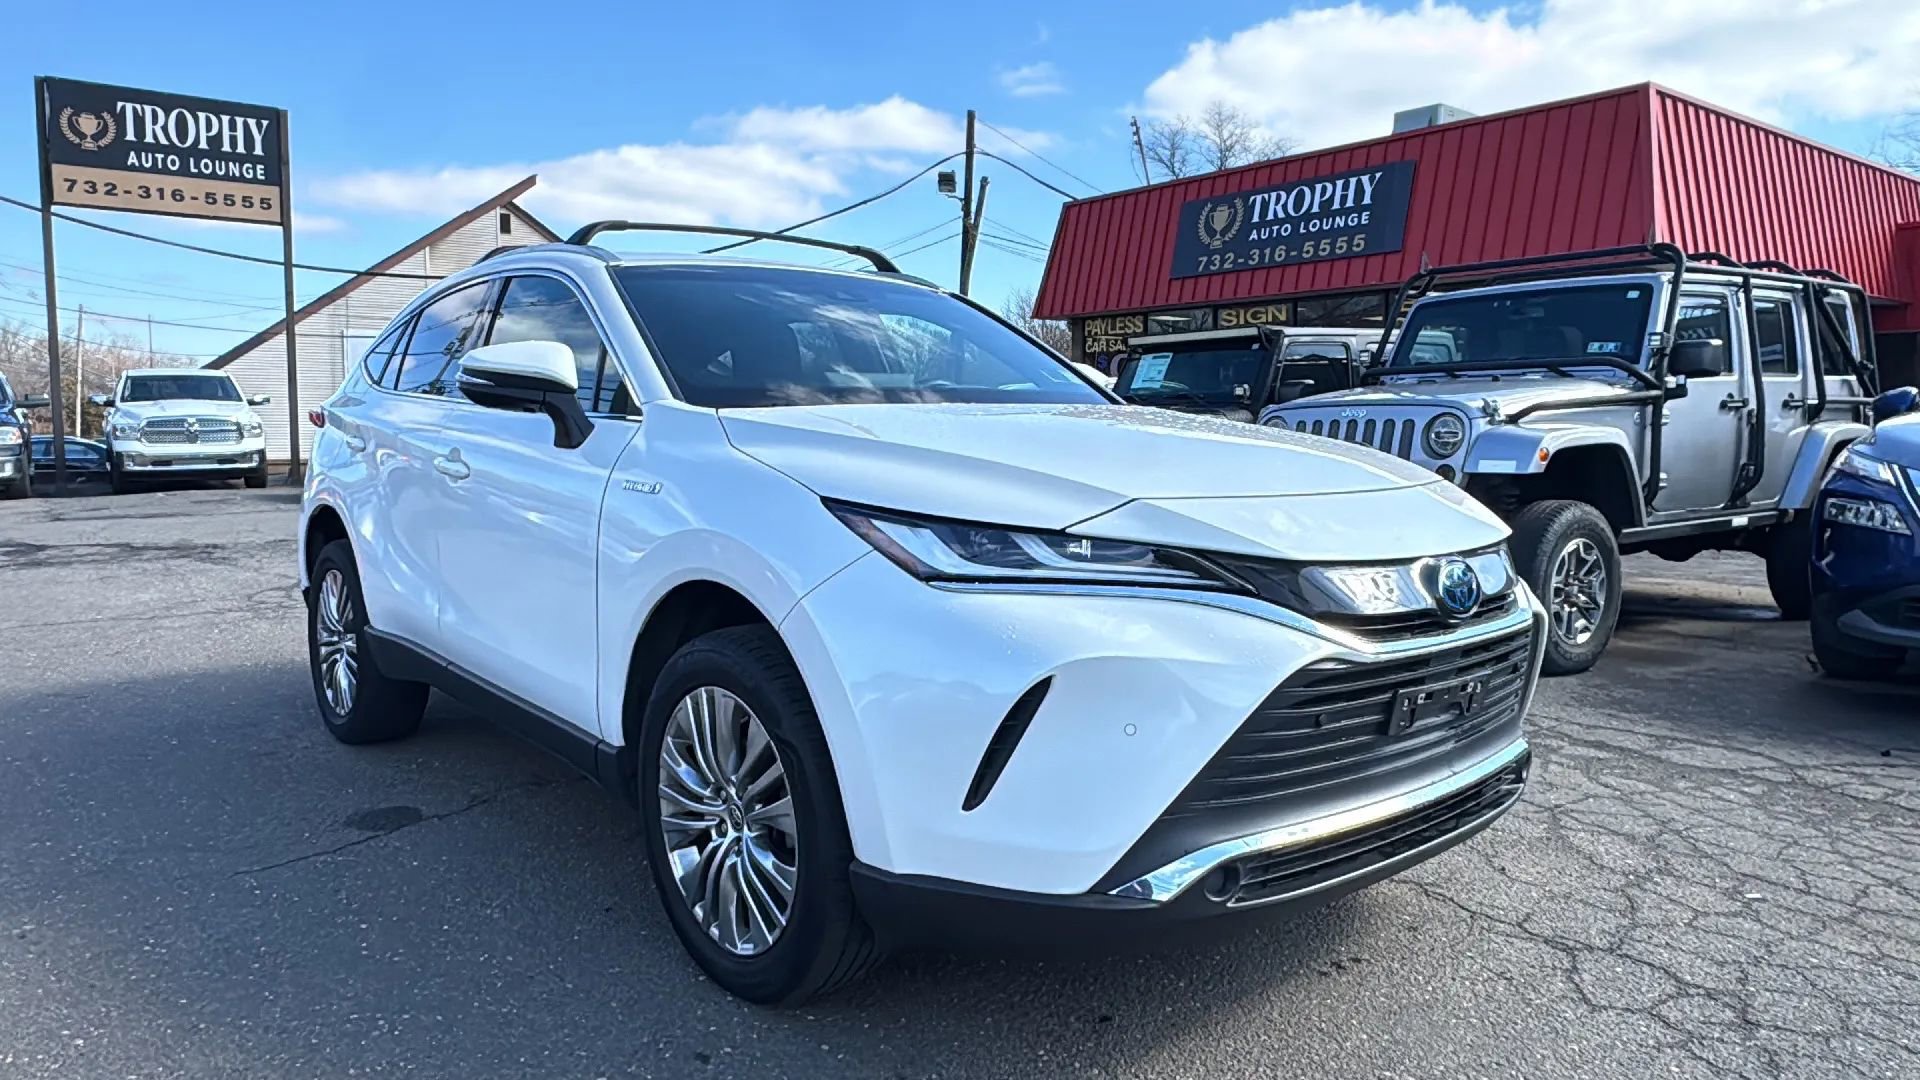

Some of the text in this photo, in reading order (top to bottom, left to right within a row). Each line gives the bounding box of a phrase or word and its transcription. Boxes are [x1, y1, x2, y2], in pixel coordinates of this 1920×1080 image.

[116, 101, 269, 156] TROPHY
[127, 151, 265, 180] AUTO LOUNGE
[63, 177, 273, 211] 732-316-5555
[1248, 171, 1383, 223] TROPHY
[1248, 211, 1370, 242] AUTO LOUNGE
[1197, 233, 1367, 272] 732-316-5555
[1085, 315, 1144, 336] PAYLESS
[1221, 304, 1287, 326] SIGN
[1085, 338, 1127, 353] CAR SAL
[1341, 408, 1367, 418] Jeep
